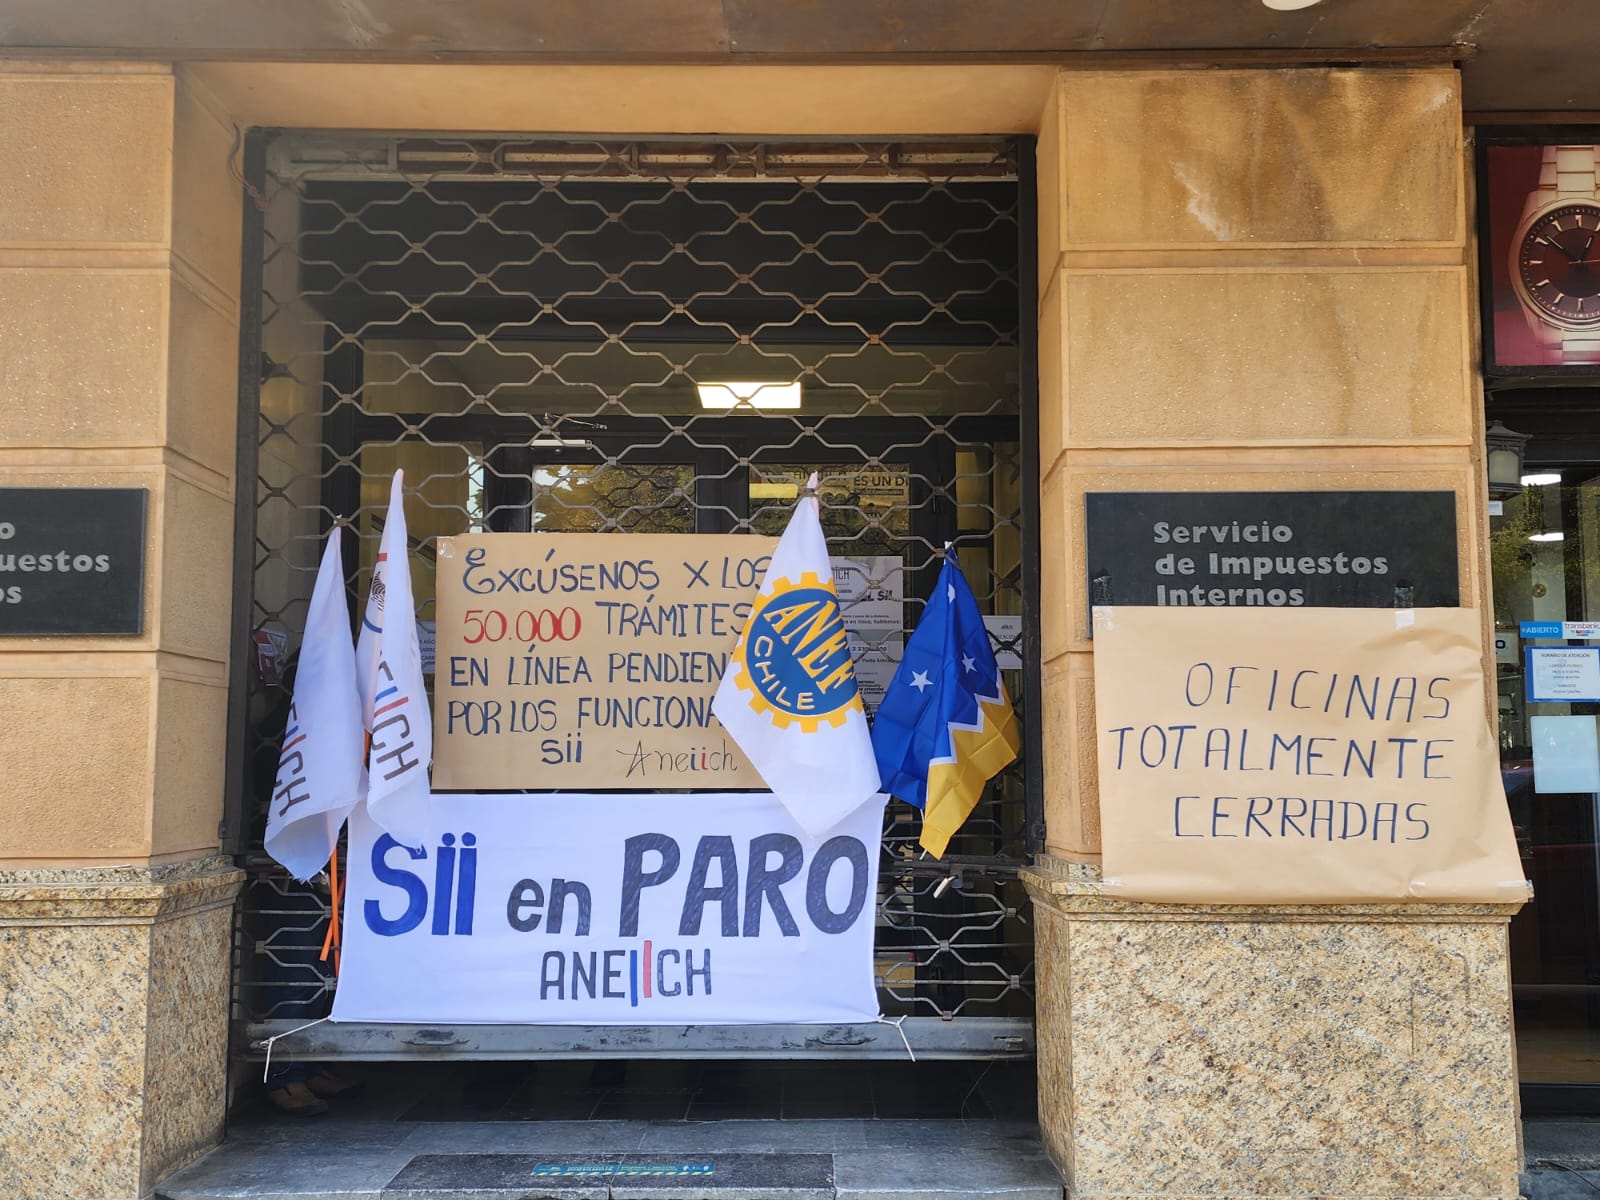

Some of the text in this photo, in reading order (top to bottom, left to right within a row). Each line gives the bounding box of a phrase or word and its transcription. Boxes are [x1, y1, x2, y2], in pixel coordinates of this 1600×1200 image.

[1153, 520, 1293, 544] Servicio
[0, 550, 110, 573] uestos
[463, 548, 660, 594] EXCÚSENOS
[683, 560, 709, 589] X
[1155, 552, 1389, 581] de Impuestos
[0, 586, 22, 604] s
[1156, 584, 1305, 607] Internos
[463, 594, 753, 644] 50.000 TRÁMITES
[1526, 626, 1559, 634] ABIERTO
[450, 644, 733, 687] EN LÍNEA PENDIEN
[754, 635, 816, 710] CHILE
[1185, 663, 1452, 723] OFICINAS
[448, 700, 501, 736] POR
[510, 699, 557, 733] LOS
[615, 739, 738, 778] Aneiich
[1108, 724, 1455, 779] TOTALMENTE
[1175, 796, 1430, 843] CERRADAS
[506, 877, 592, 936] en
[618, 832, 869, 938] PARO
[540, 941, 713, 1008] ANEIICH
